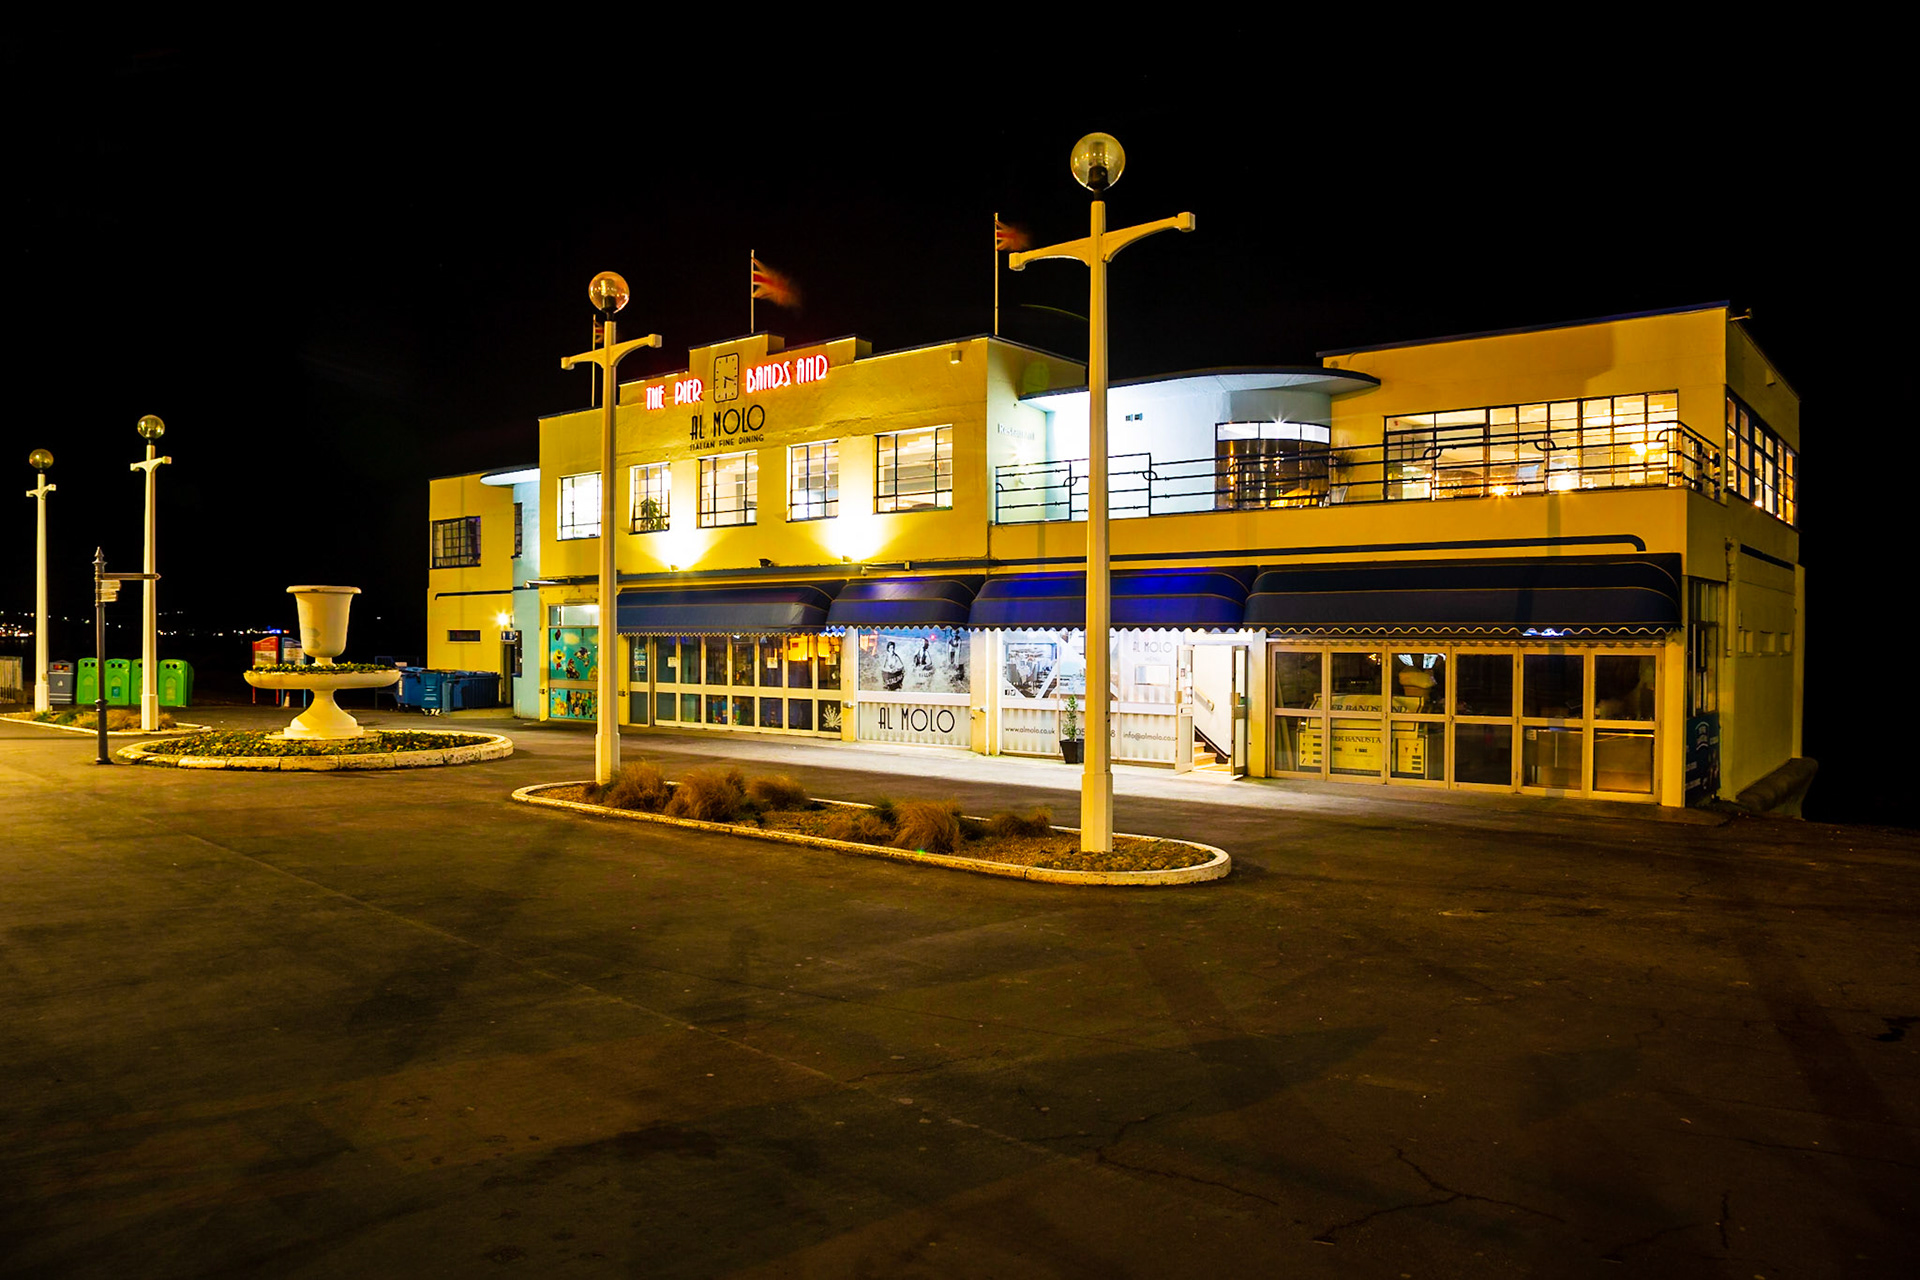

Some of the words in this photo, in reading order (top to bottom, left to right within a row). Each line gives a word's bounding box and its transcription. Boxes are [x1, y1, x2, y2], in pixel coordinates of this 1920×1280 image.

[646, 384, 666, 411] THE
[674, 378, 704, 406] PIER
[746, 360, 792, 394] BANDS
[796, 354, 828, 386] AND
[689, 415, 705, 440] AL
[713, 404, 765, 437] MOLO
[690, 441, 715, 451] ITALIAN
[719, 438, 735, 447] FINE
[738, 434, 764, 445] DINING
[878, 707, 893, 730] AL
[901, 708, 956, 733] MOLO
[1005, 726, 1055, 734] www.almolo.co.uk
[1123, 731, 1176, 741] info@almolo.co.u
